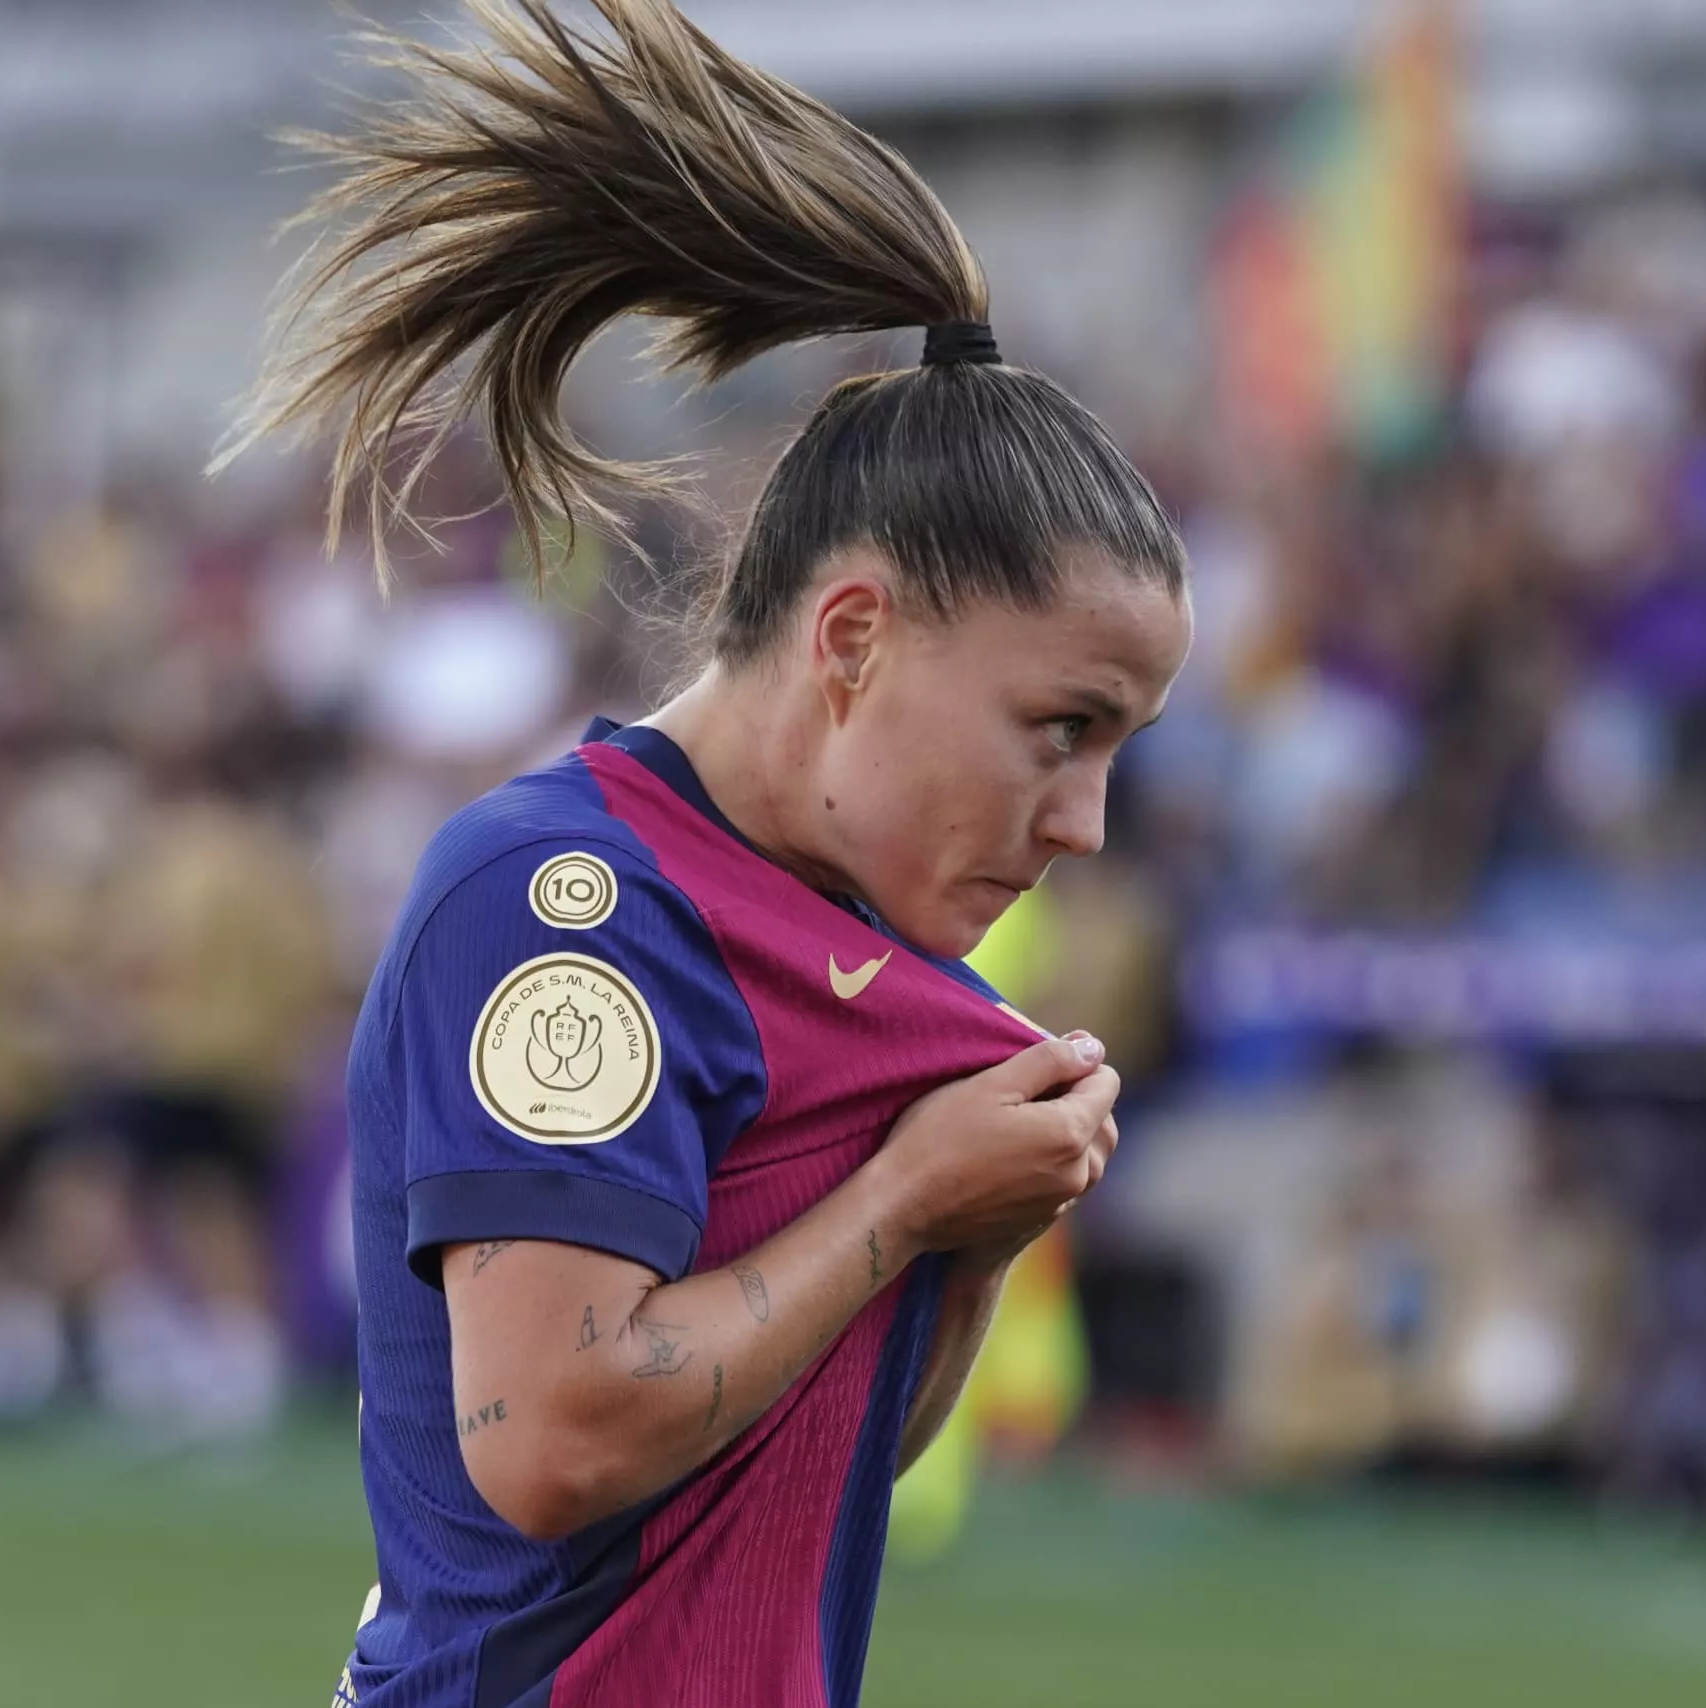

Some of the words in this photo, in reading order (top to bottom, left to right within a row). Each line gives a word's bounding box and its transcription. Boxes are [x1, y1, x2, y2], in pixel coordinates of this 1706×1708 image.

[552, 878, 595, 903] 10
[492, 1002, 521, 1050] COPA
[519, 979, 545, 1000] DE
[549, 974, 586, 989] S.M.
[590, 983, 613, 1004] LA
[612, 1003, 640, 1061] REINA
